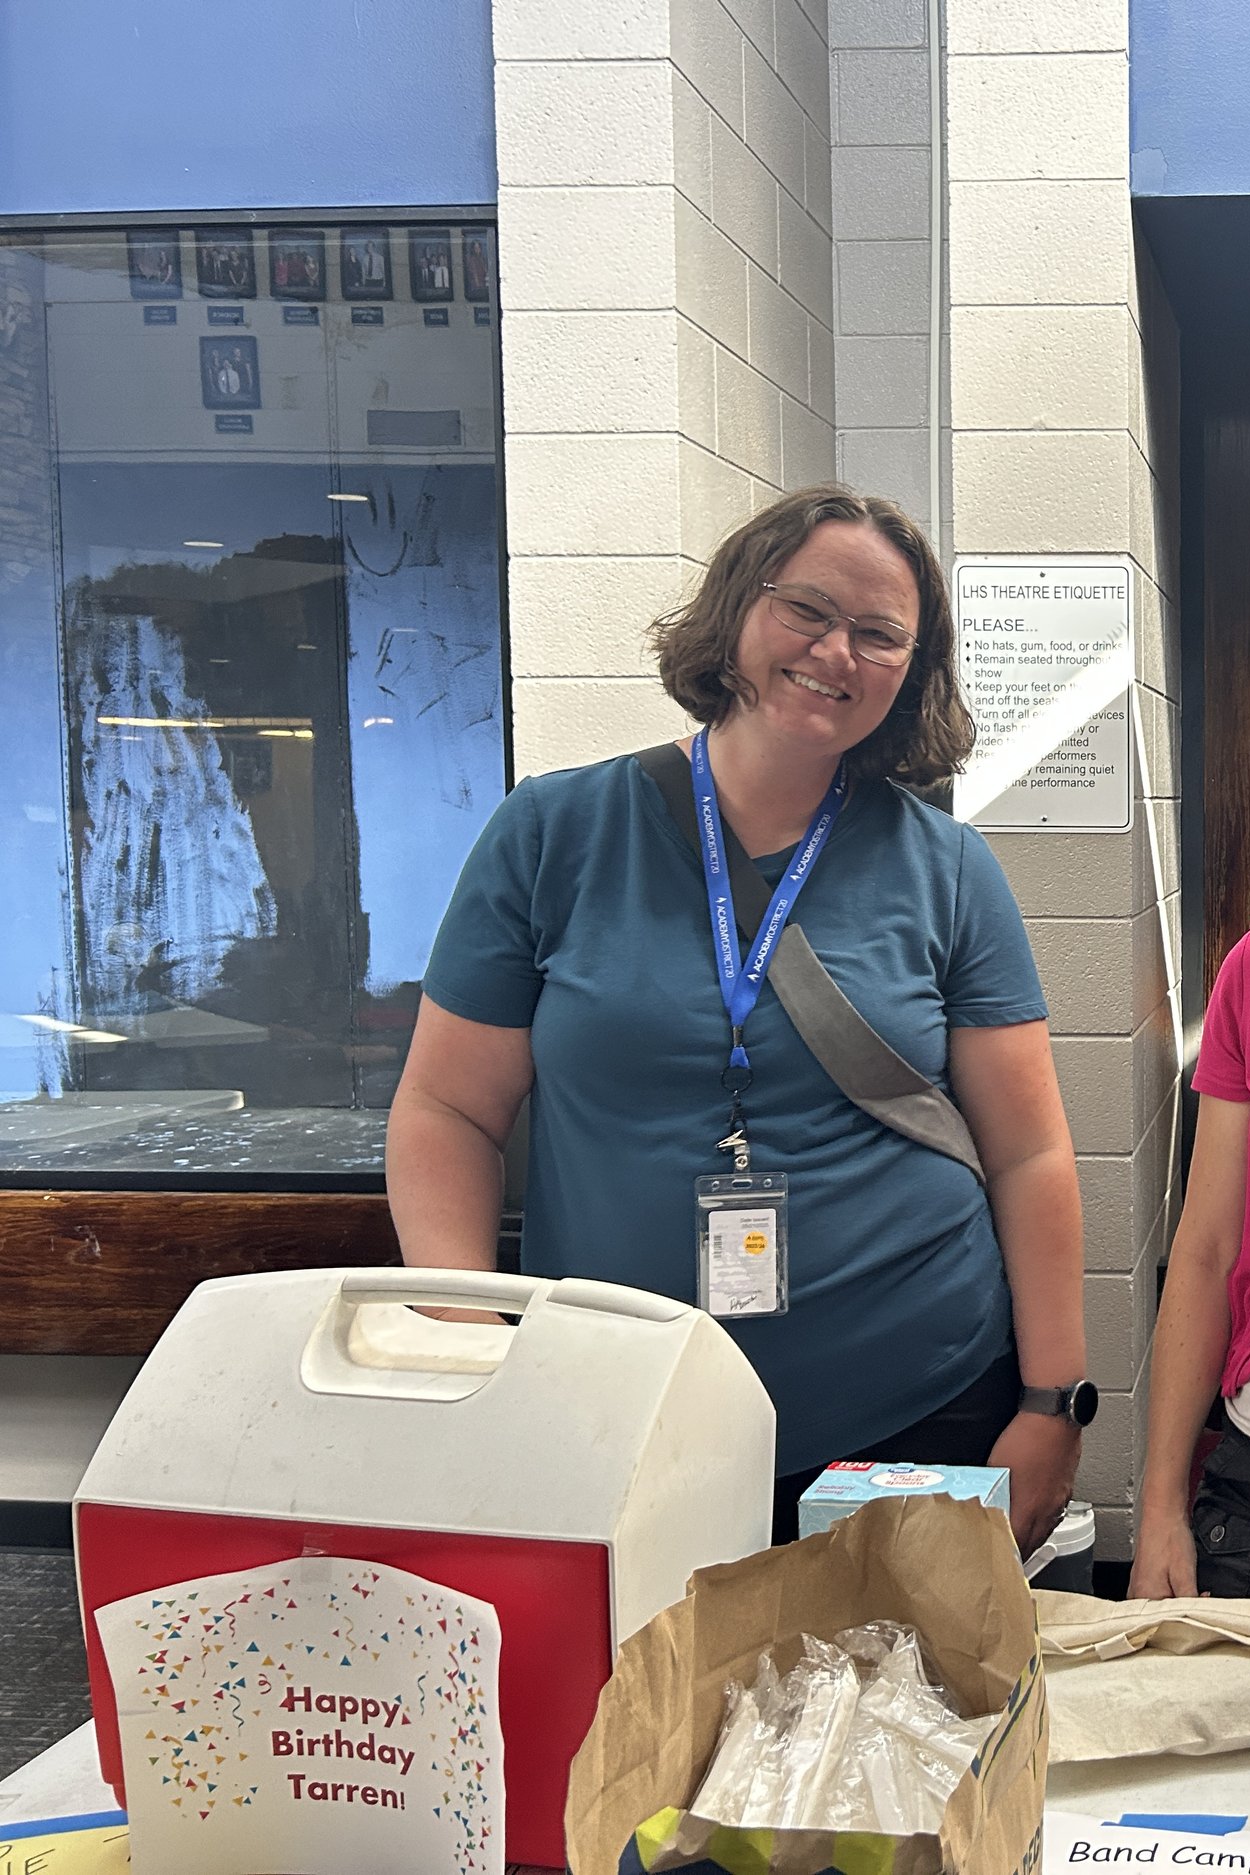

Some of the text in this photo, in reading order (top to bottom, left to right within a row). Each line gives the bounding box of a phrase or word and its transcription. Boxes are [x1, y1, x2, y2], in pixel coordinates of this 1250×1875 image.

[963, 585, 1125, 600] LHS THEATRE ETIQUETTE
[963, 618, 1038, 632] PLEASE...
[974, 640, 989, 650] No
[993, 640, 1017, 652] hats,
[1021, 642, 1046, 653] gum,
[1050, 640, 1075, 652] food,
[1079, 642, 1089, 651] or
[974, 654, 1015, 664] Remain
[1018, 655, 1053, 664] seated
[974, 668, 1002, 678] show
[975, 682, 1002, 693] Keep
[1005, 684, 1028, 694] your
[1031, 682, 1051, 692] feet
[1053, 684, 1066, 692] on
[974, 695, 995, 705] and
[997, 695, 1011, 705] off
[1013, 695, 1030, 705] the
[976, 708, 998, 719] Turn
[1002, 709, 1015, 719] off
[1017, 709, 1030, 719] all
[1088, 710, 1125, 720] evices
[976, 722, 990, 732] No
[993, 722, 1018, 733] flash
[1088, 725, 1100, 733] or
[976, 736, 1003, 746] video
[1035, 764, 1086, 776] remaining
[1089, 764, 1115, 777] quiet
[1031, 777, 1096, 789] performance
[286, 1686, 400, 1729] Happy
[272, 1730, 416, 1776] Birthday
[287, 1773, 407, 1811] Tarren!
[1068, 1841, 1159, 1863] Band
